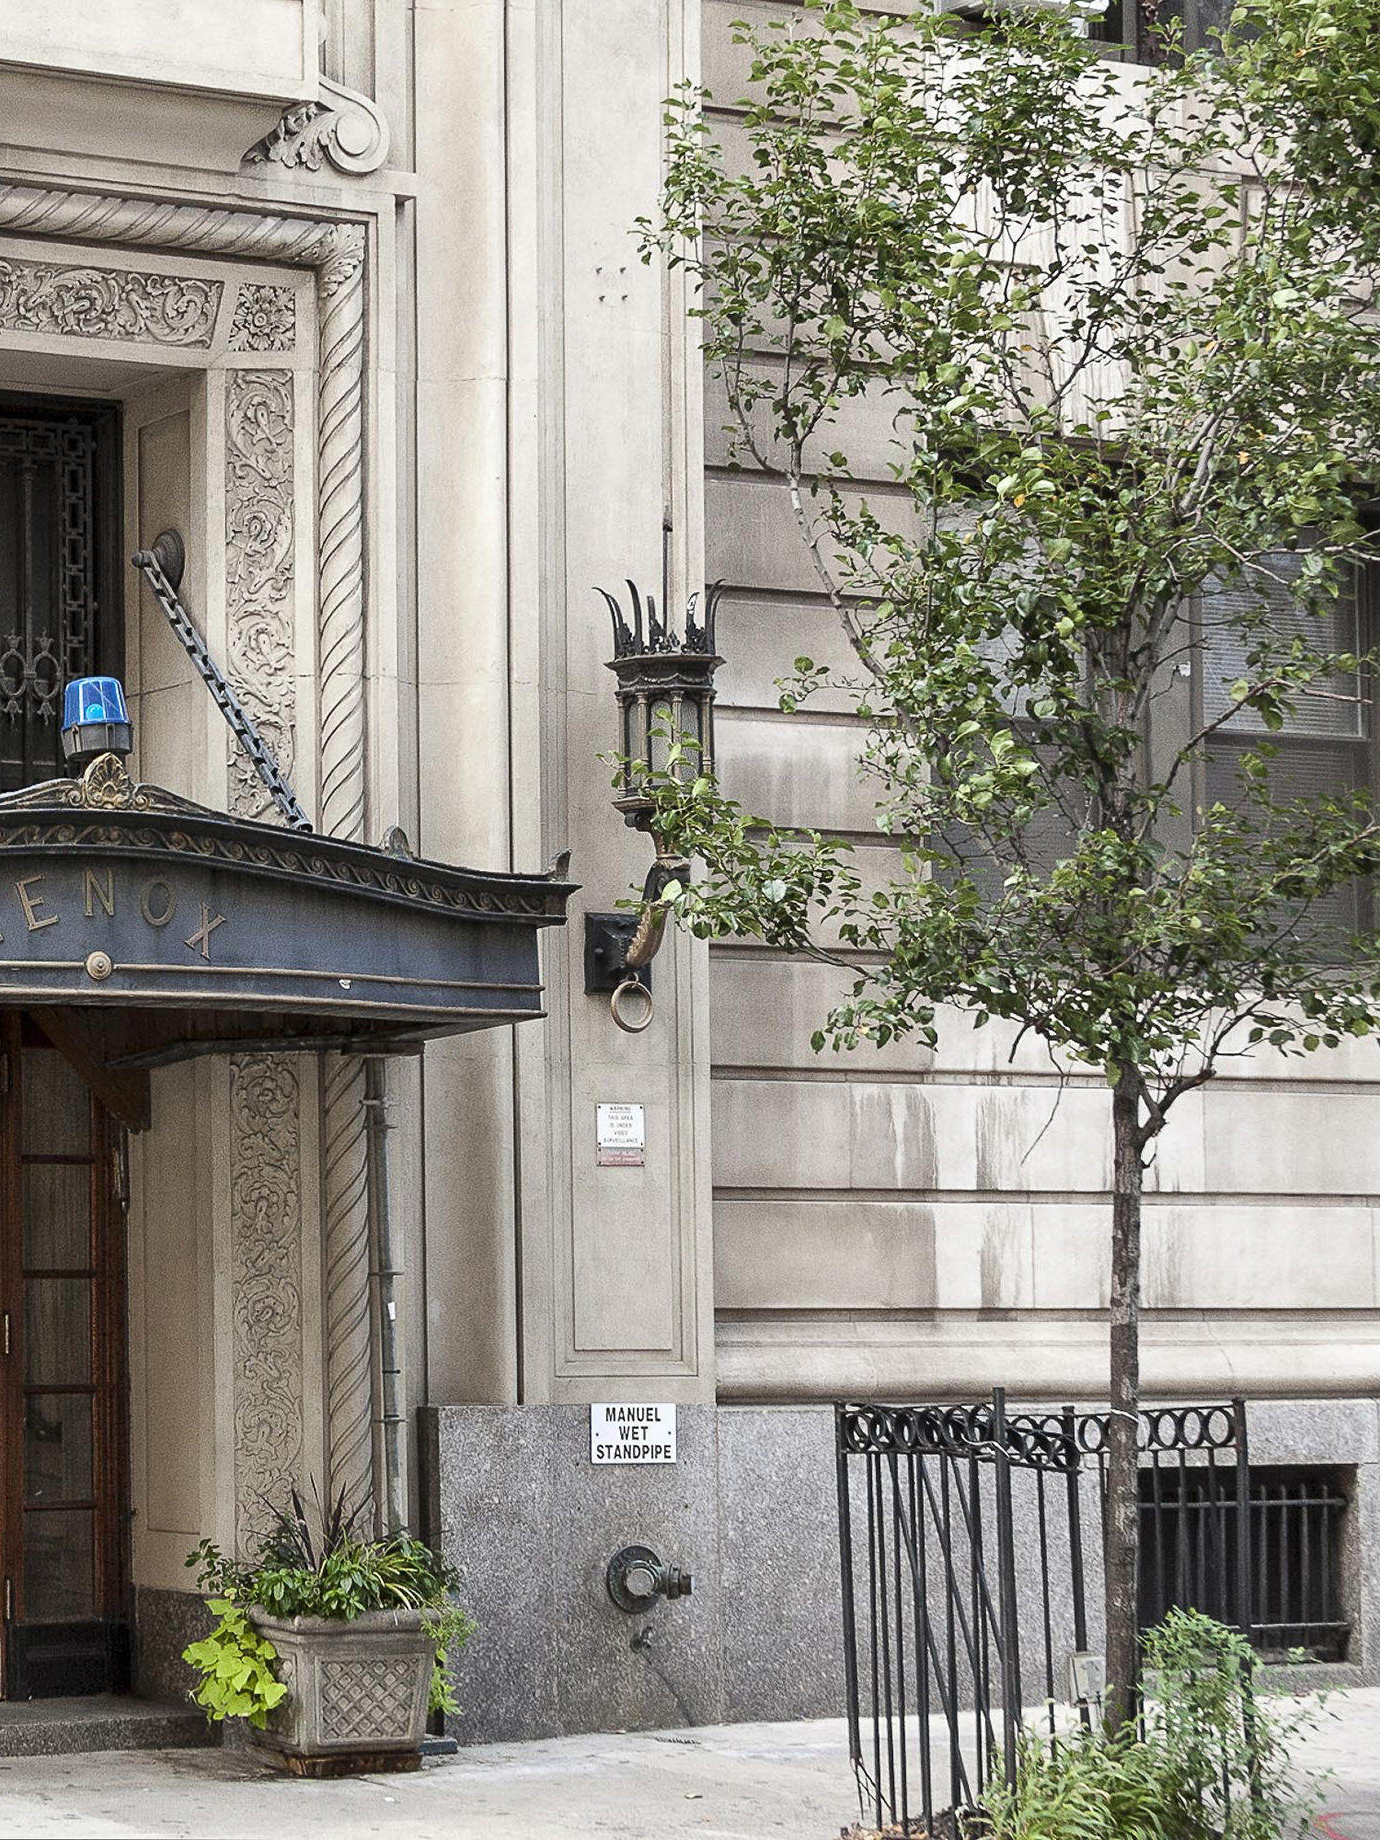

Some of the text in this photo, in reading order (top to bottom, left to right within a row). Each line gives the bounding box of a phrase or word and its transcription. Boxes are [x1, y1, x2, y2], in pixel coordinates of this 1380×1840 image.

[605, 1407, 661, 1422] MANUEL
[619, 1425, 649, 1440] WET
[596, 1444, 672, 1459] STANDPIPE
